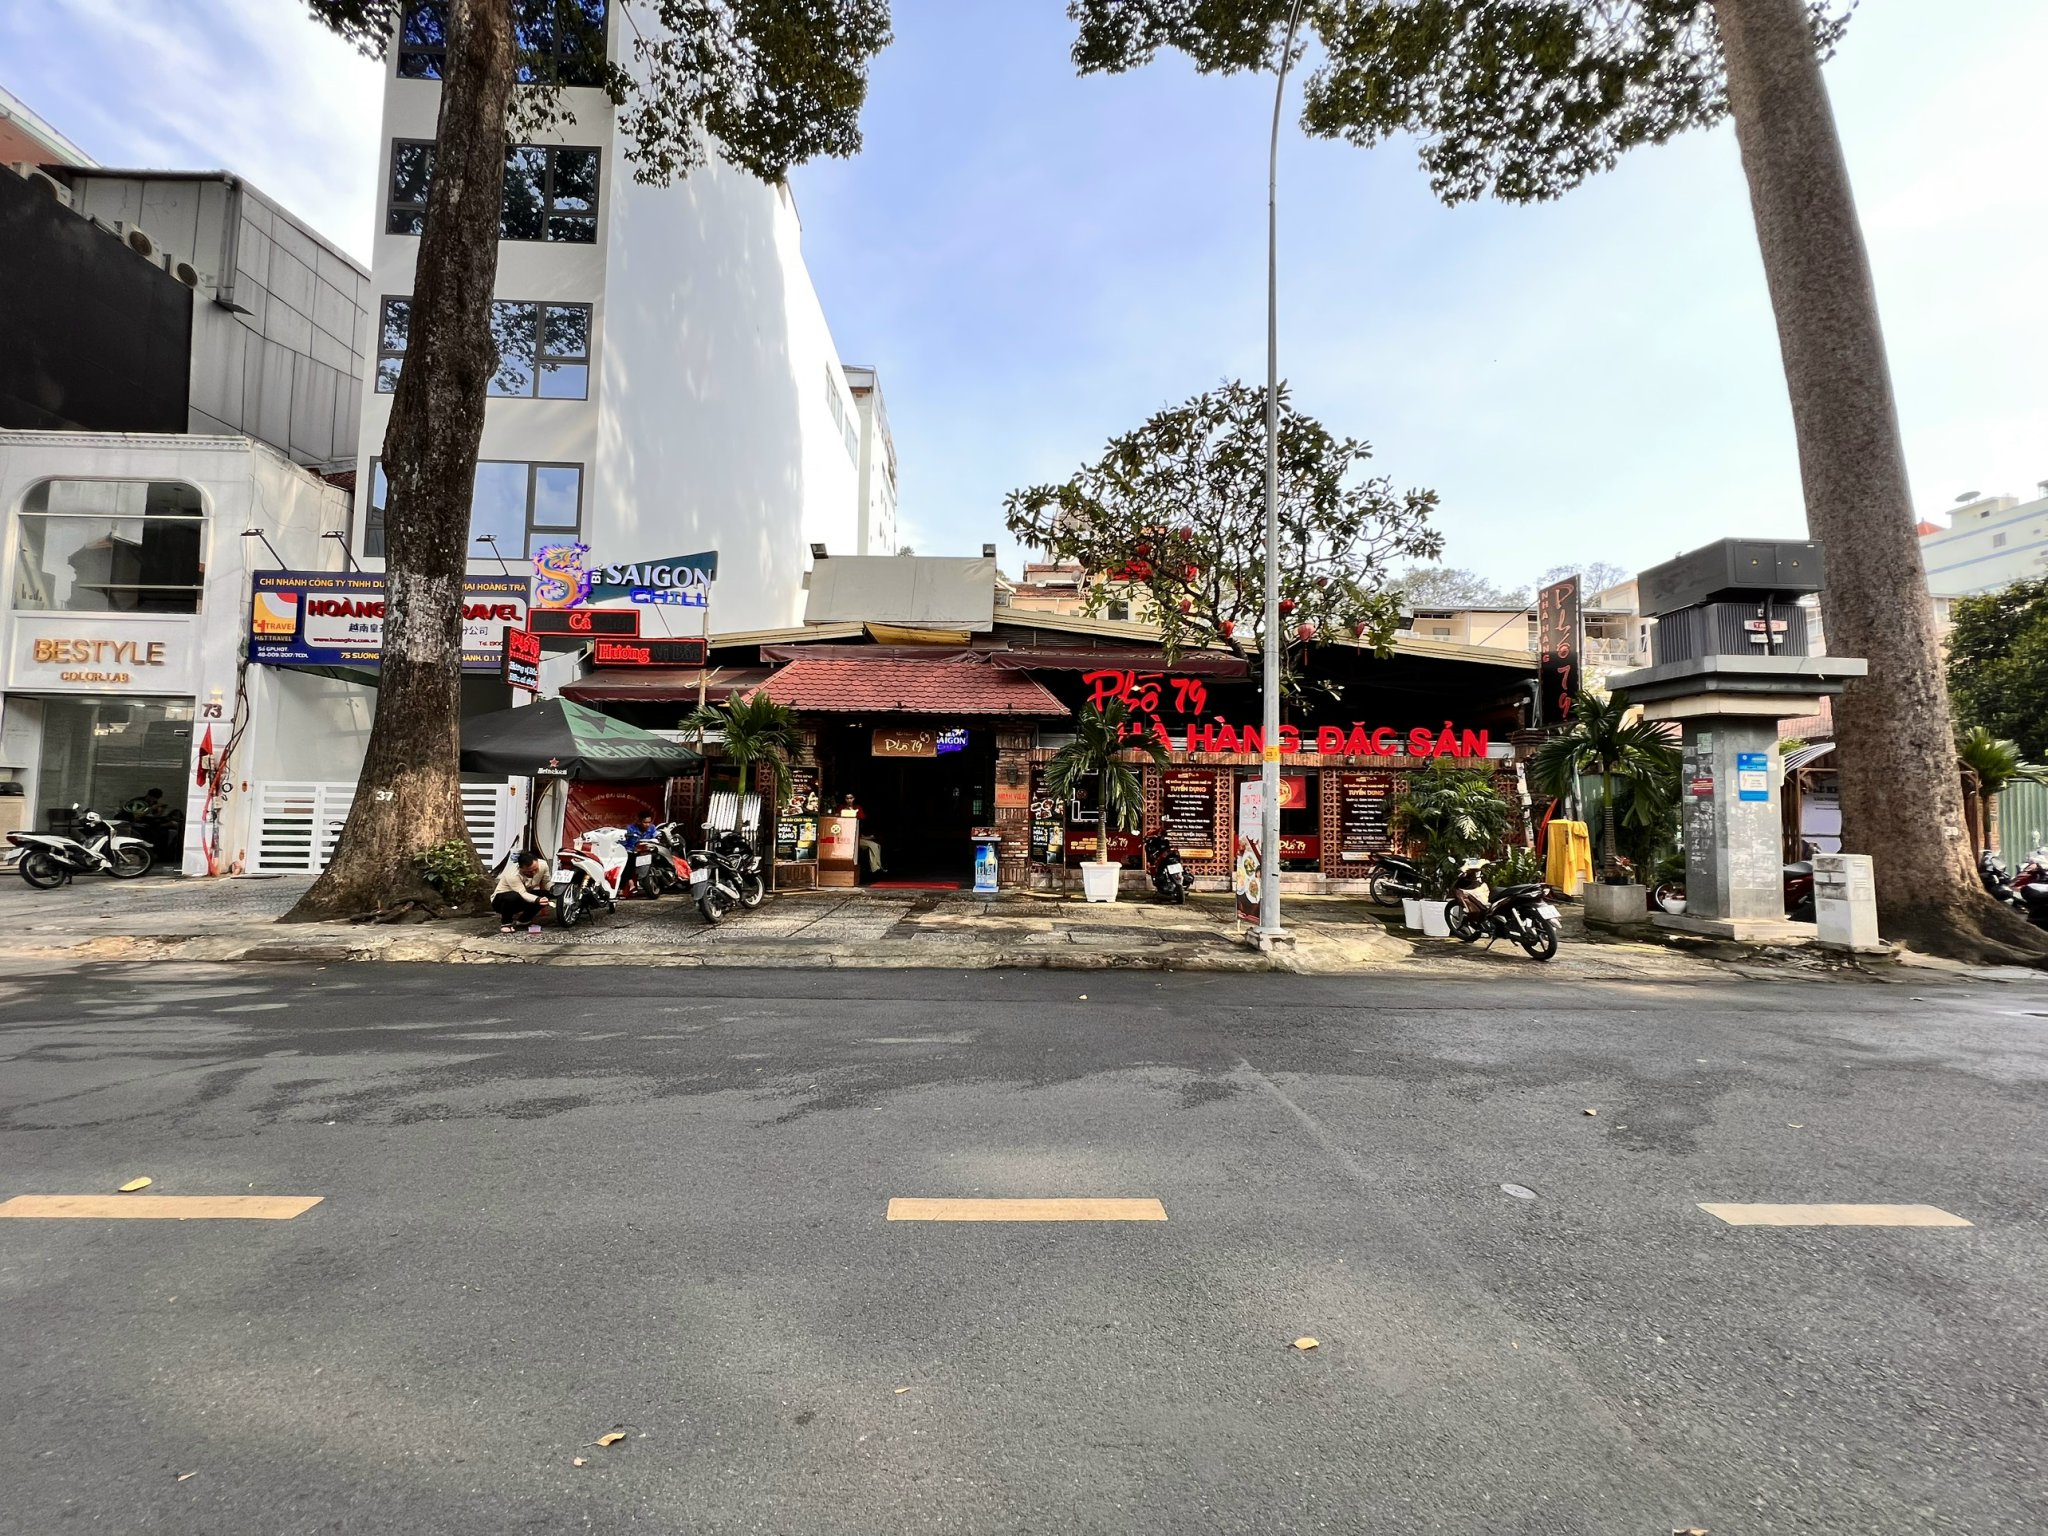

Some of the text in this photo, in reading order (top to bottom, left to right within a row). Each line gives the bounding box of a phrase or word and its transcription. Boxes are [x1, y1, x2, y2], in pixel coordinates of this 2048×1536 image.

[260, 578, 274, 586] CHI
[277, 577, 307, 587] NHÁNH
[309, 577, 333, 587] CÔNG
[335, 579, 346, 587] TY
[347, 580, 371, 588] TNHH
[372, 580, 384, 588] DU
[477, 582, 507, 591] HOÀNG
[606, 563, 712, 590] SAIGON
[630, 588, 709, 608] CHILL
[308, 597, 523, 621] HOÀNG RAVEL
[265, 622, 296, 630] TRAVEL
[569, 612, 592, 630] Cá
[33, 638, 166, 667] BESTYLE
[599, 643, 650, 664] Hương
[1170, 678, 1208, 716] 79
[201, 703, 222, 719] 73
[1187, 715, 1300, 754] HÀNG
[1407, 720, 1489, 758] SẢN
[911, 739, 923, 753] 79
[537, 767, 568, 775] Heineken
[377, 791, 393, 801] 37
[1296, 840, 1306, 850] 79
